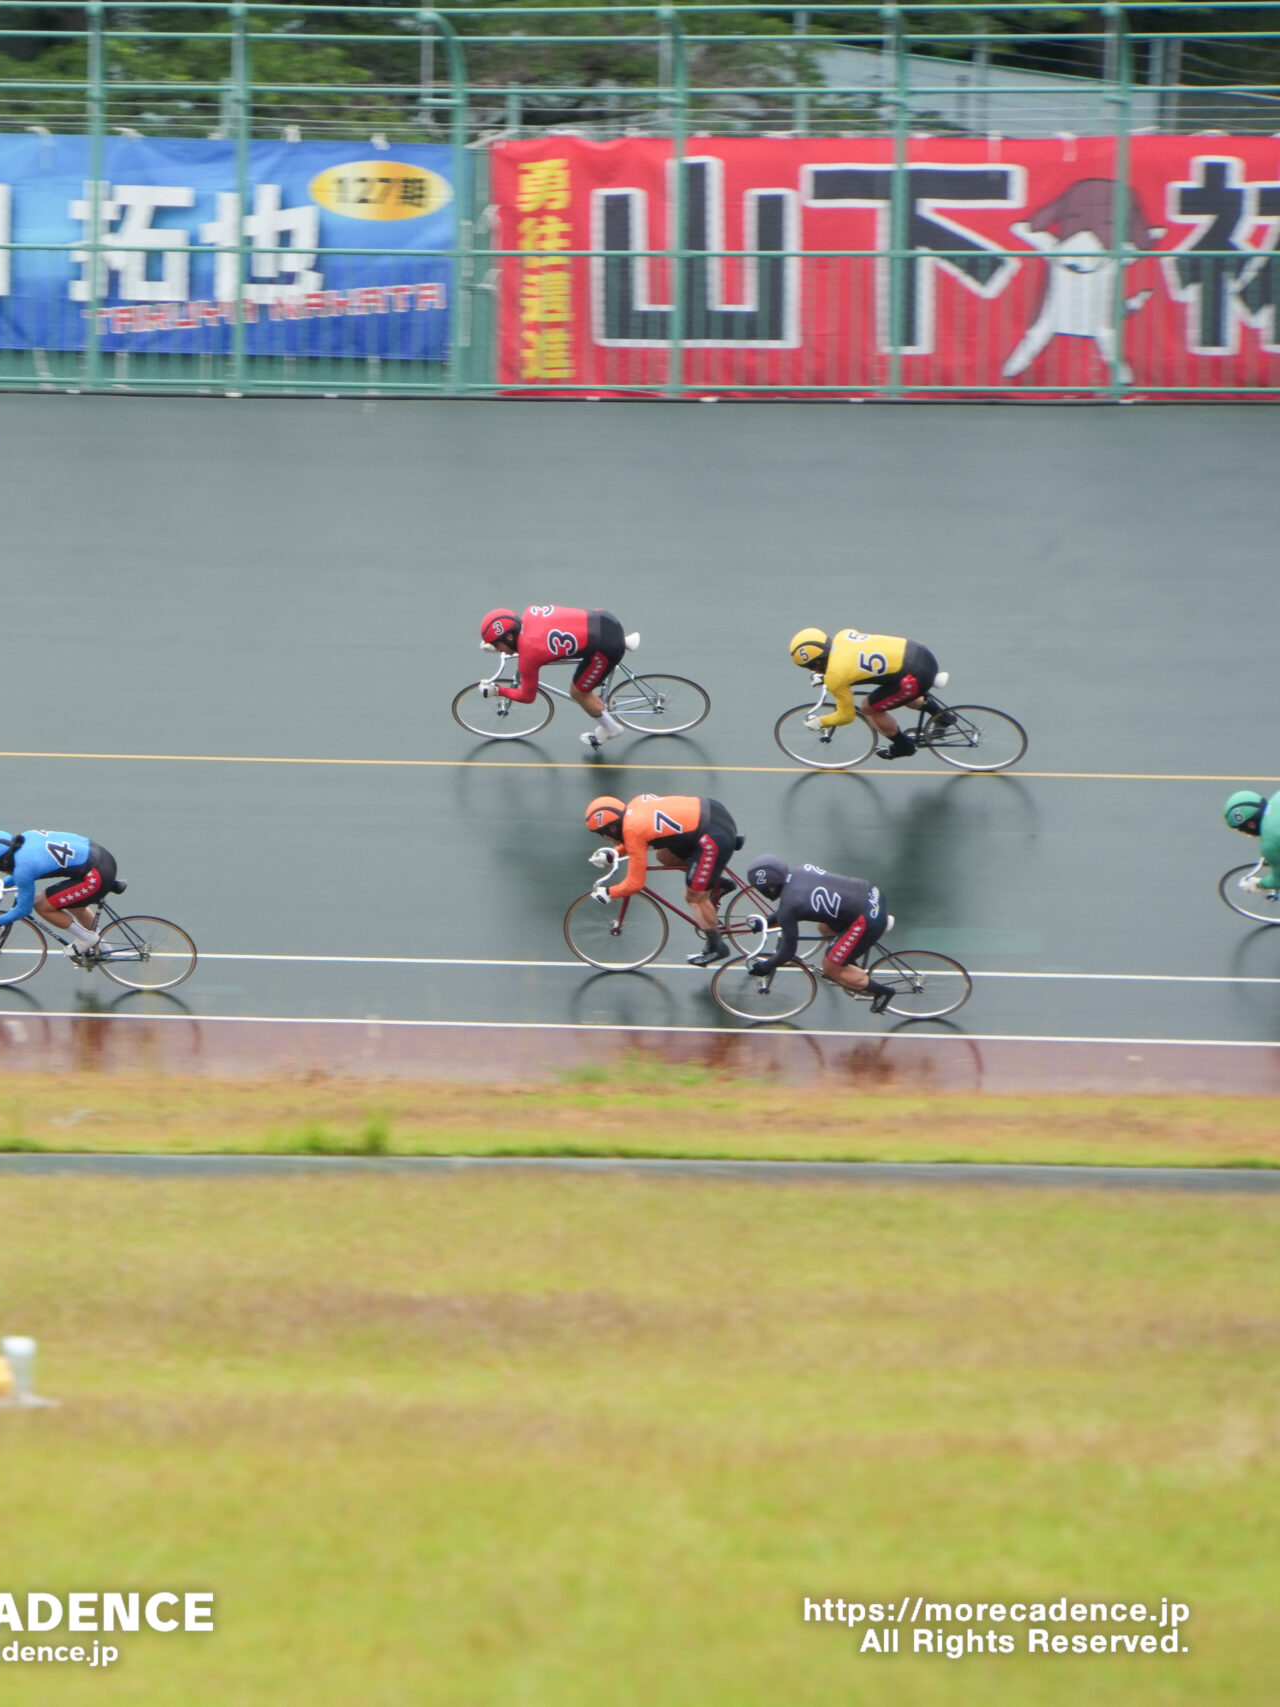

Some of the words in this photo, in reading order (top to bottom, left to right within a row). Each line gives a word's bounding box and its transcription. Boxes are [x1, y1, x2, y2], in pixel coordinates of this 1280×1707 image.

[333, 176, 429, 209] 127期
[493, 621, 504, 635] 3
[547, 629, 578, 656] 3
[799, 648, 809, 662] 5
[859, 651, 888, 676] 5
[594, 812, 605, 827] 7
[654, 810, 683, 834] 7
[1233, 809, 1245, 823] 6
[46, 841, 75, 868] 4
[756, 869, 767, 884] 2
[811, 886, 842, 919] 2
